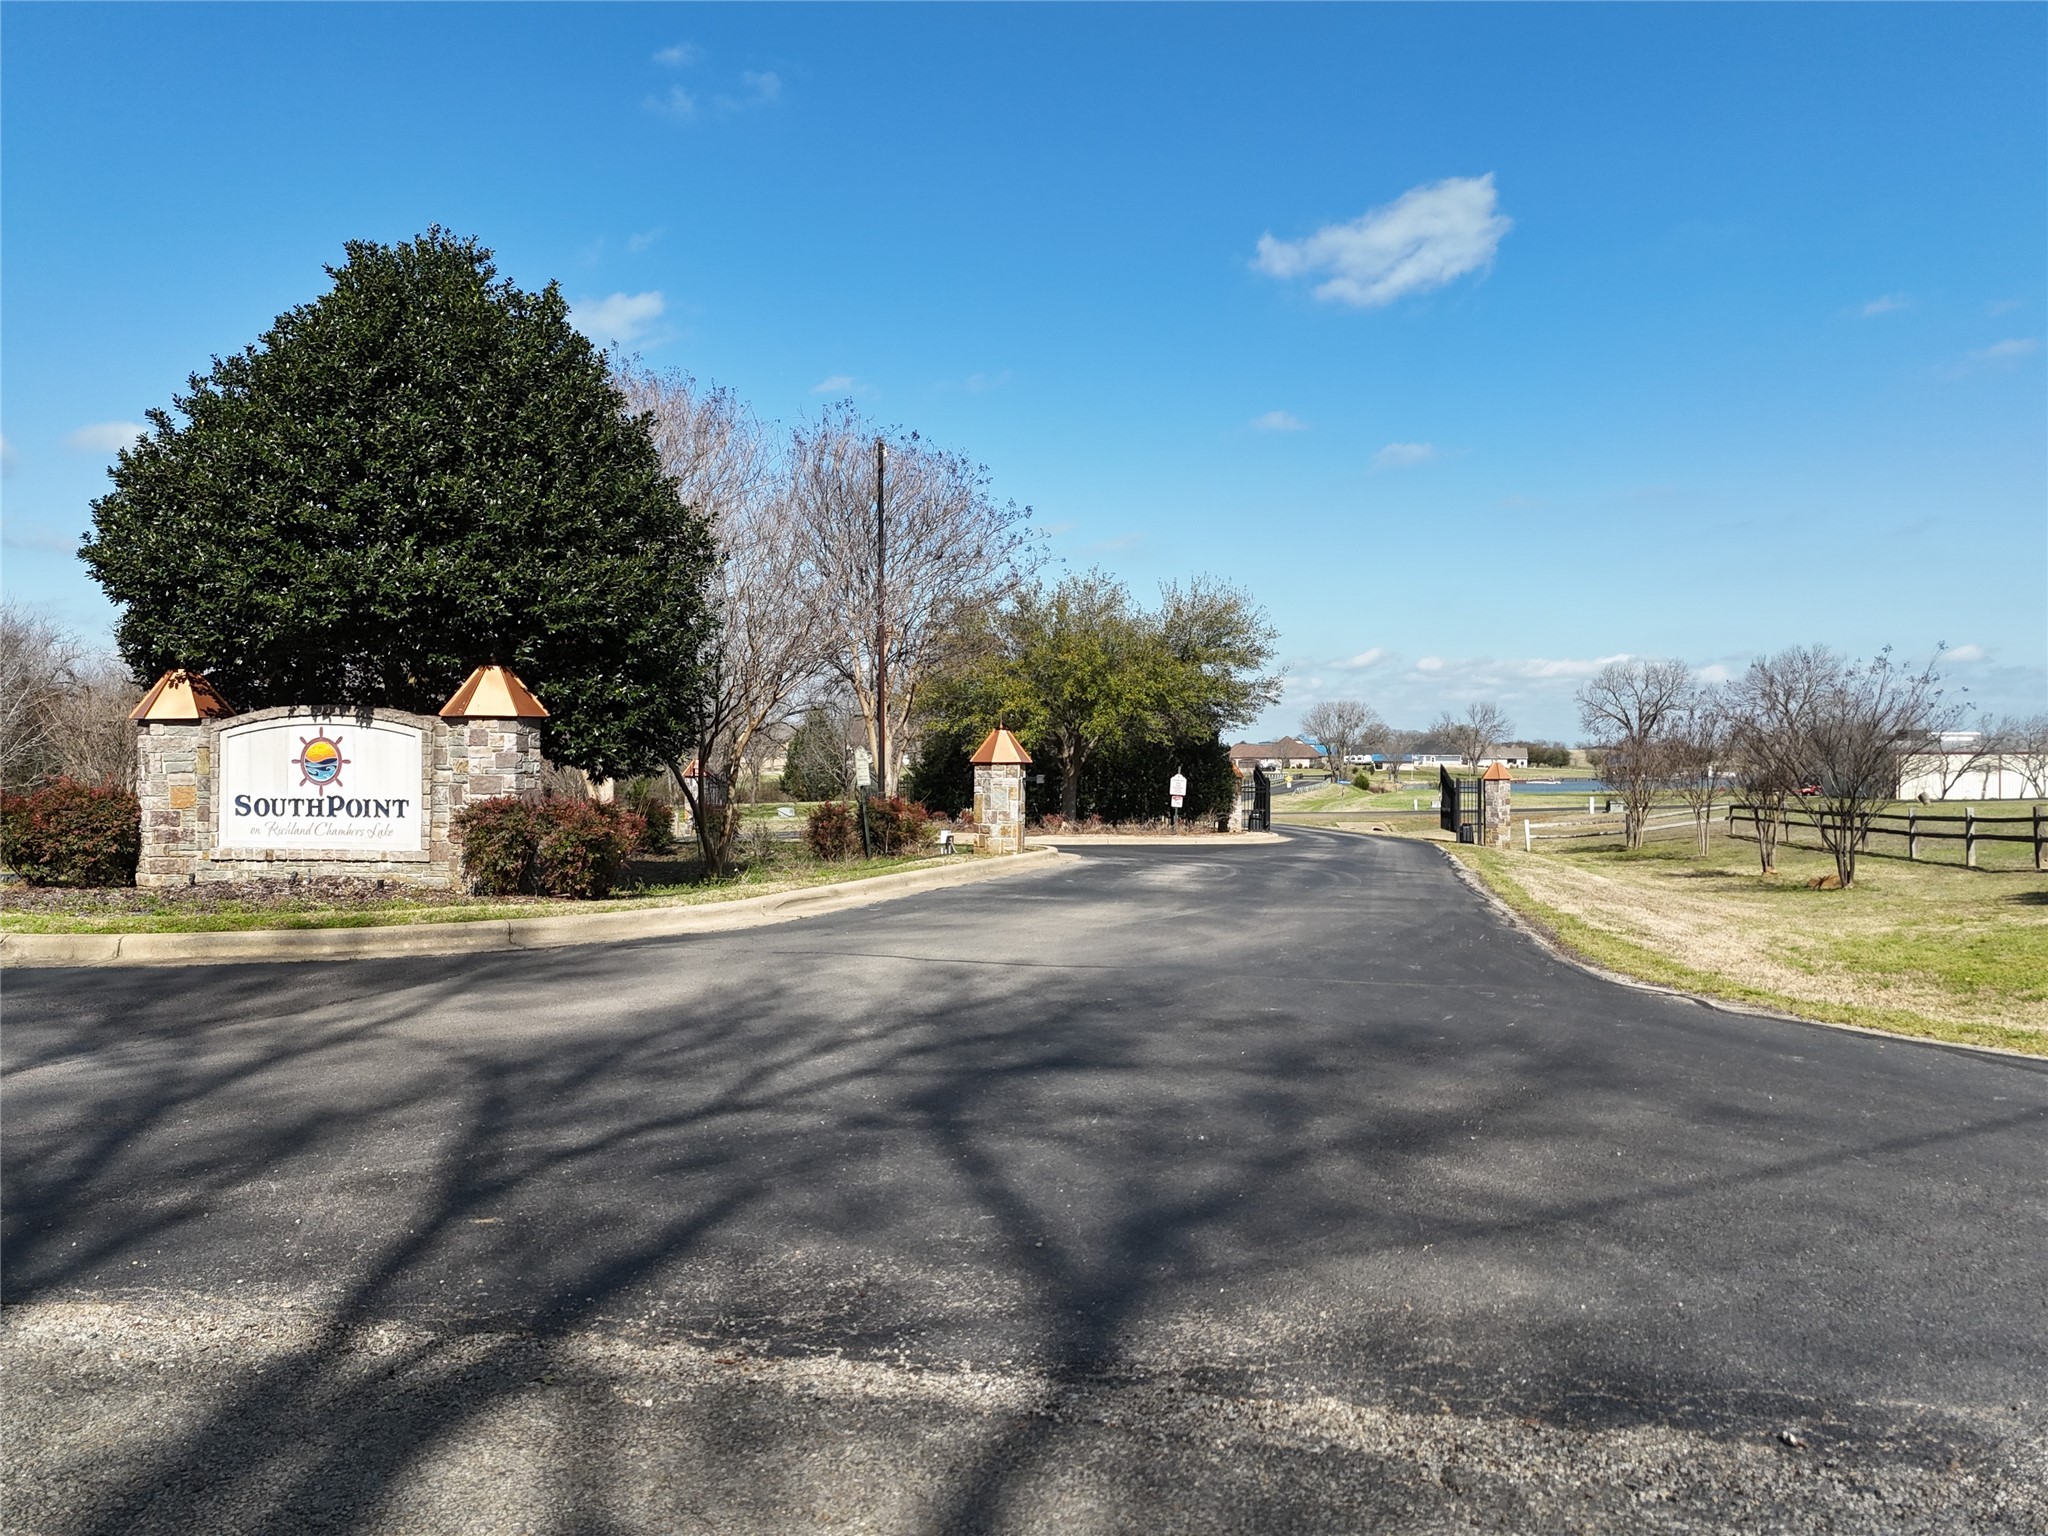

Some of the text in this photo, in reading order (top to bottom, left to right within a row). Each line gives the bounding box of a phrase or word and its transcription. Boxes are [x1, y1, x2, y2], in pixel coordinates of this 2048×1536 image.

[249, 821, 394, 839] on Richland Chambers Lake
